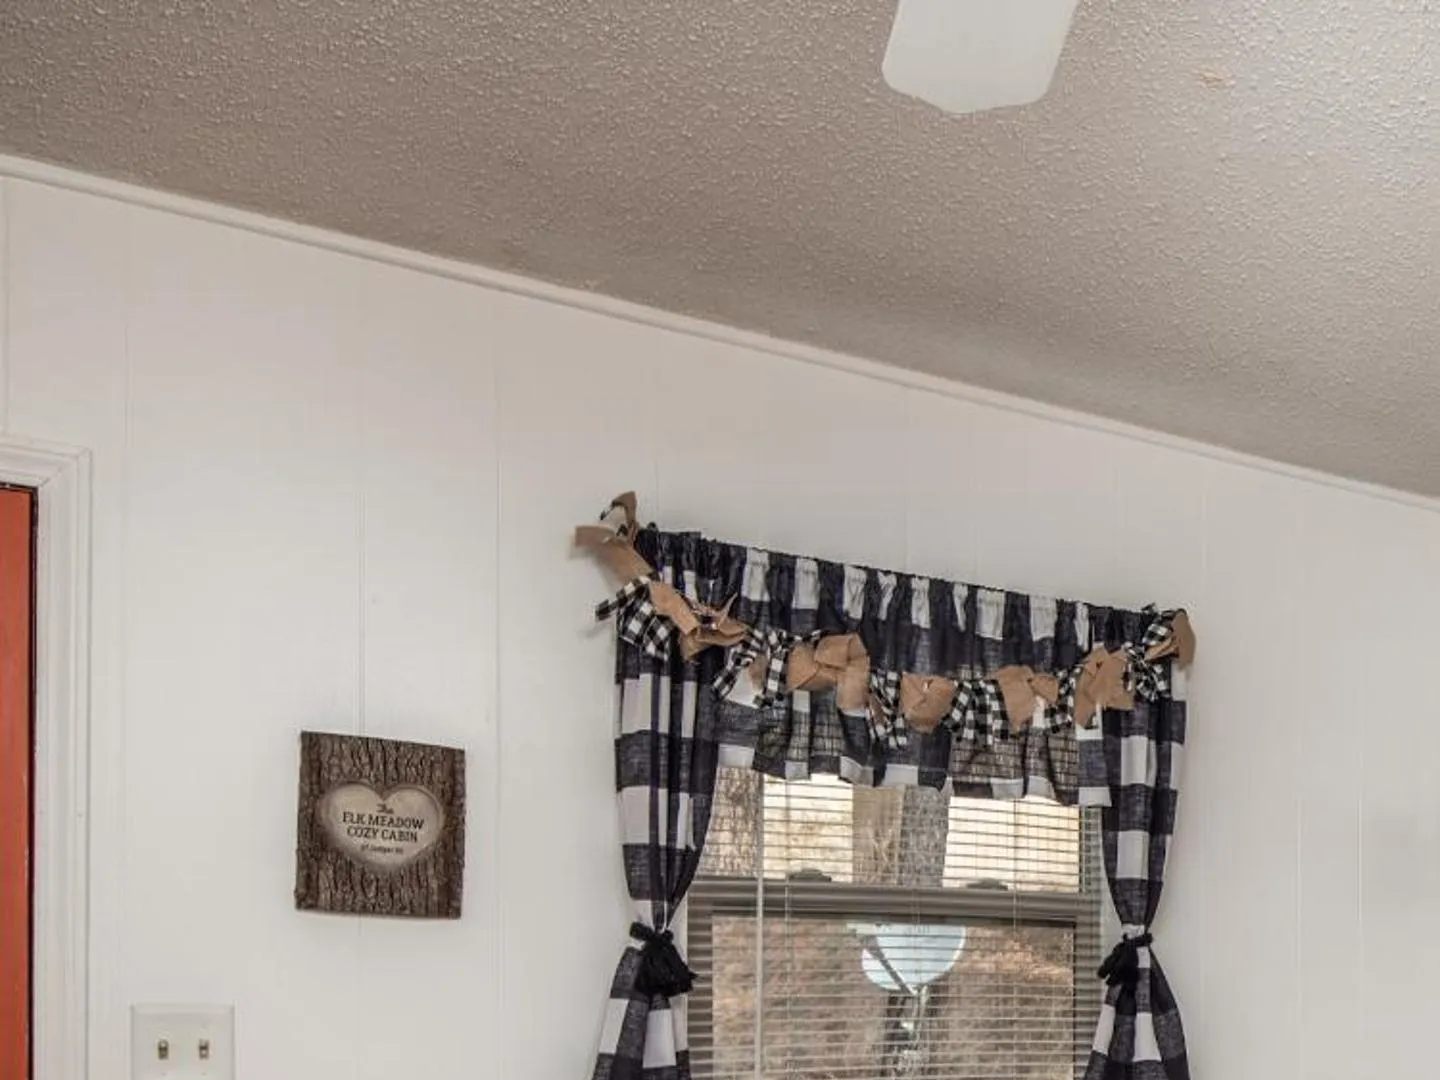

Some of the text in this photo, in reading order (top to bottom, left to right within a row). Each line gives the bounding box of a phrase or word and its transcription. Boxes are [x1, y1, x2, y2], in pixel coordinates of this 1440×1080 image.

[342, 811, 425, 830] ELK MEADOW
[346, 825, 418, 843] COZY CABIN
